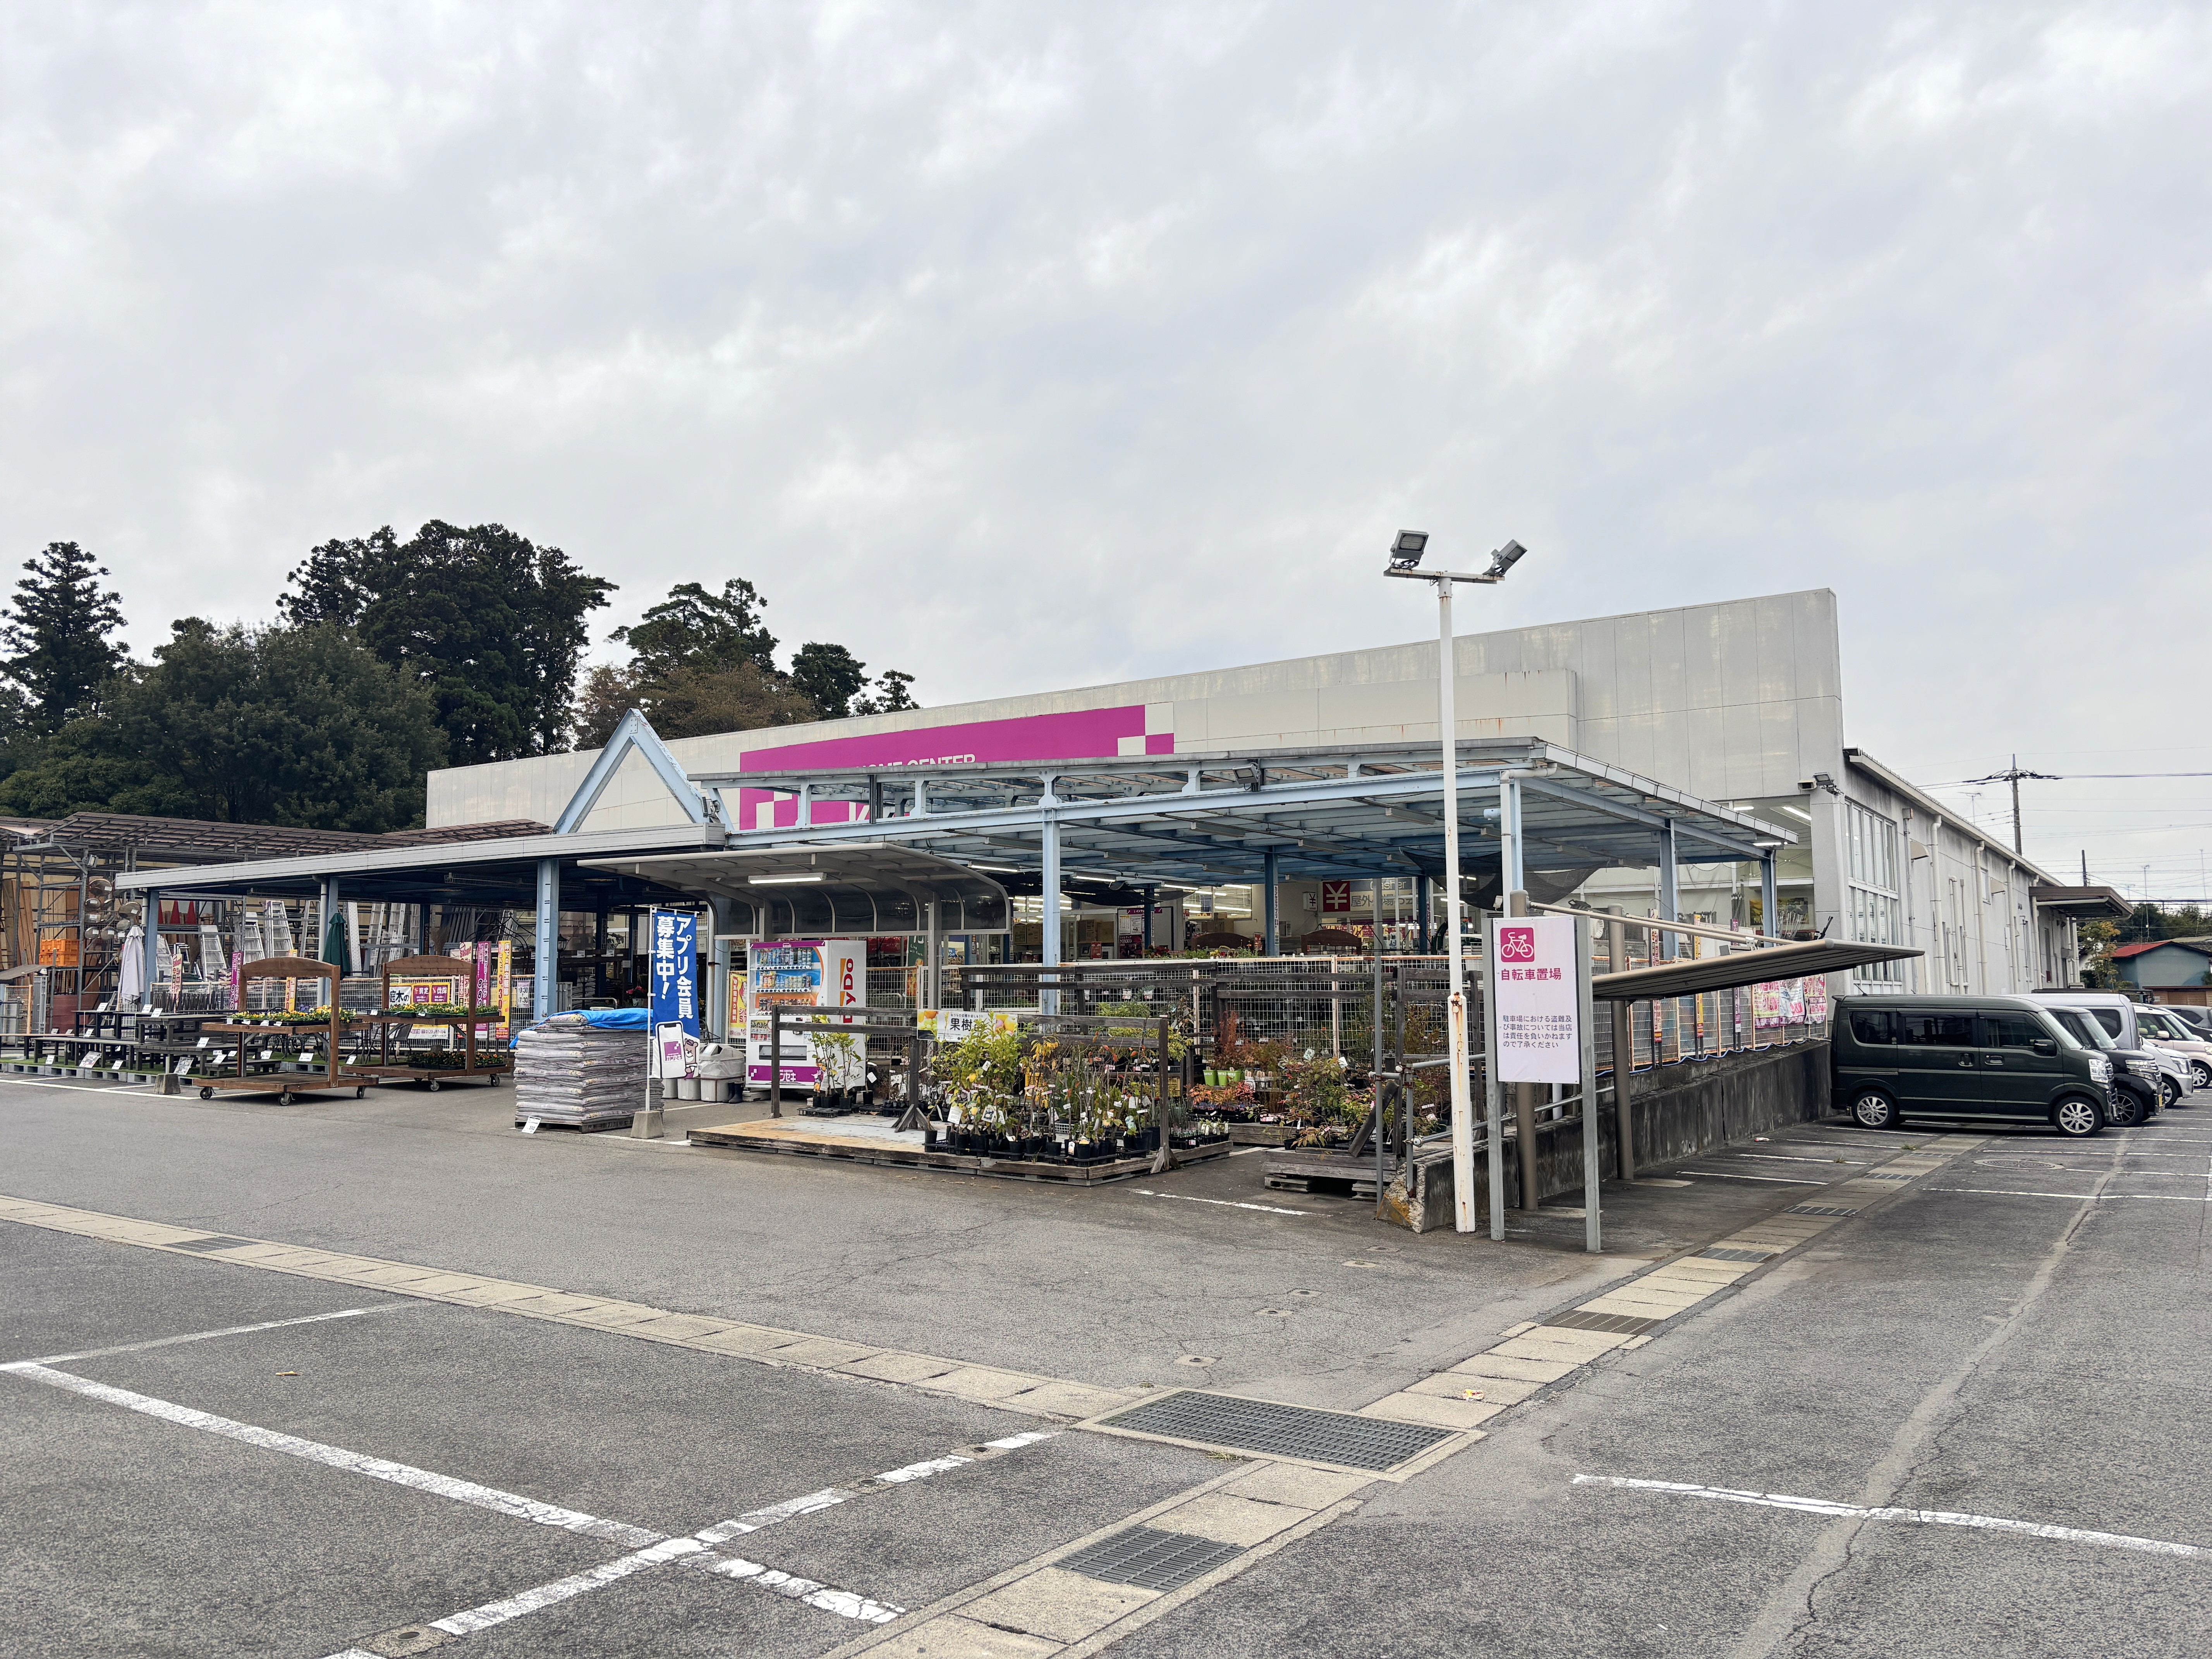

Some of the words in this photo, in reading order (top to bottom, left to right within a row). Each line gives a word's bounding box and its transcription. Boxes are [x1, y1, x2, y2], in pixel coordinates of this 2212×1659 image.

[1370, 880, 1406, 890] sher
[656, 916, 675, 1000] 募集中!
[677, 917, 693, 1019] アプリ会員
[1501, 968, 1561, 981] 自転車置場
[779, 1072, 796, 1082] ンセキ
